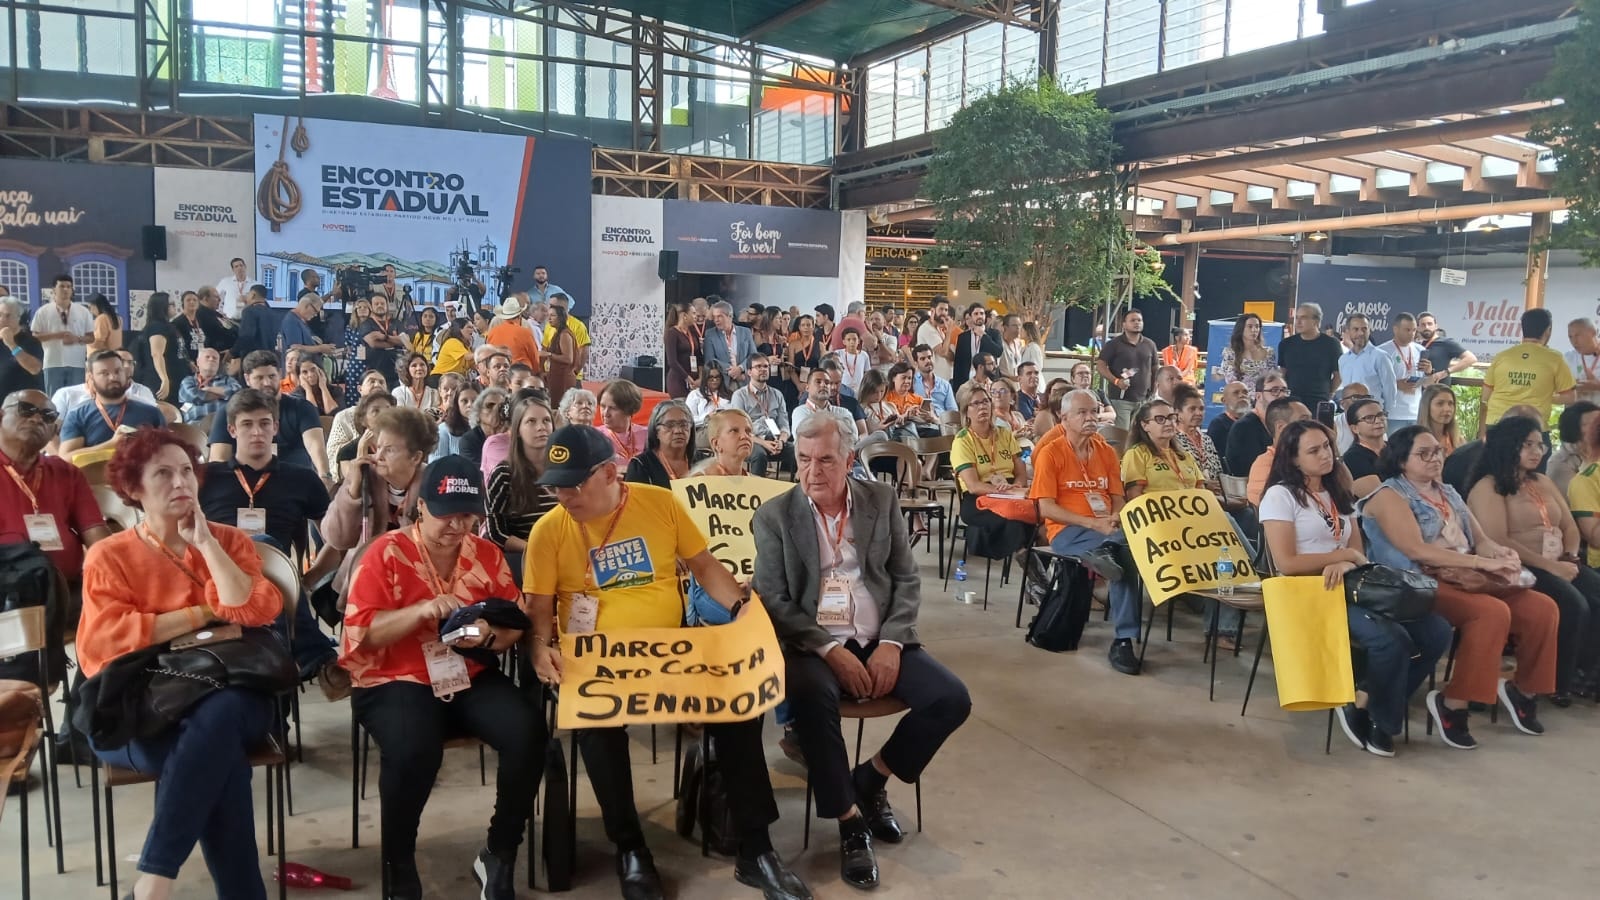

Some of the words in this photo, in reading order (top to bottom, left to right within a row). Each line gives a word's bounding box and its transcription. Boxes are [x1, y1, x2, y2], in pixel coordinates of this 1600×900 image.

[321, 164, 465, 191] ENCONTRO
[178, 203, 232, 214] ENCONTRO
[321, 185, 489, 216] ESTADUAL
[44, 206, 85, 225] uai
[174, 211, 237, 224] ESTADUAL
[601, 233, 655, 244] ESTADUAL
[605, 226, 651, 235] ENCONTRO
[730, 220, 753, 241] Foi
[755, 222, 782, 240] bom
[736, 236, 751, 254] te
[752, 239, 777, 254] ver!
[1462, 299, 1520, 321] Mala
[1471, 321, 1484, 337] e
[1511, 378, 1531, 387] MAIA
[977, 454, 991, 464] 30
[1153, 462, 1170, 471] 30
[446, 485, 479, 495] MORAES
[685, 482, 762, 511] MARCO
[708, 513, 744, 537] ATO
[1126, 495, 1209, 534] MARCO
[595, 539, 642, 562] GENTE
[1145, 536, 1182, 564] ATO
[1181, 526, 1242, 550] COSTA
[598, 551, 645, 573] FELIZ
[574, 633, 693, 658] MARCO
[594, 664, 652, 680] ATO
[660, 647, 766, 677] COSTA
